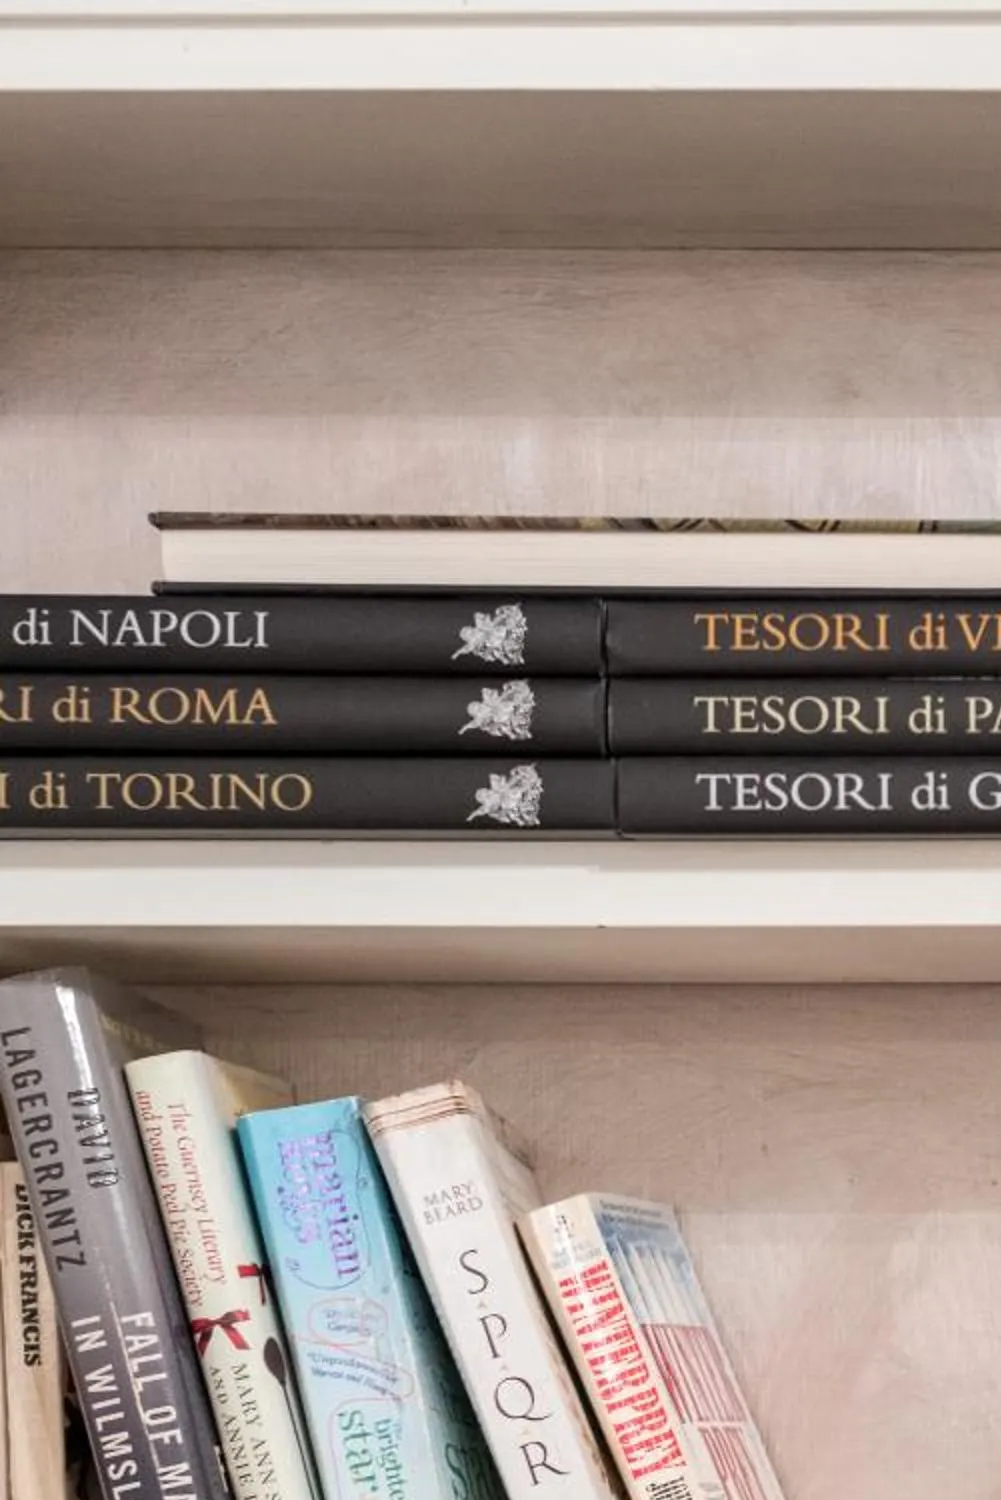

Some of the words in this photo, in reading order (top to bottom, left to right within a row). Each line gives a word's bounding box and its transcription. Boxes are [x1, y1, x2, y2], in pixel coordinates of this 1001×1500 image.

[12, 608, 52, 646] di
[69, 609, 269, 648] NAPOLI
[694, 613, 888, 652] TESORI
[908, 611, 946, 651] di
[52, 685, 92, 723] di
[108, 686, 278, 725] ROMA
[694, 695, 889, 734] TESORI
[908, 694, 946, 734] di
[29, 771, 70, 809] di
[86, 772, 312, 812] TORINO
[695, 771, 892, 811] TESORI
[910, 770, 949, 811] di
[136, 1090, 163, 1122] and
[167, 1102, 192, 1131] The
[1, 1026, 87, 1271] LAGERCRANTZ
[67, 1087, 120, 1188] DAVID
[147, 1124, 170, 1179] Potato
[160, 1181, 187, 1214] Peel
[177, 1136, 209, 1214] Guernsey
[423, 1180, 475, 1208] MARY
[308, 1130, 361, 1277] marian
[423, 1197, 484, 1225] BEARD
[198, 1218, 227, 1286] Literary
[177, 1247, 203, 1307] Society
[20, 1256, 42, 1367] FRANCIS
[71, 1315, 108, 1353] IN
[121, 1311, 168, 1395] FALL
[559, 1258, 651, 1401] WINTER
[606, 1386, 687, 1481] PREY
[144, 1404, 184, 1446] OF
[210, 1365, 229, 1406] AND
[222, 1415, 254, 1488] ANNIE
[232, 1361, 263, 1427] MARY
[250, 1437, 277, 1486] ANN
[338, 1409, 379, 1493] star
